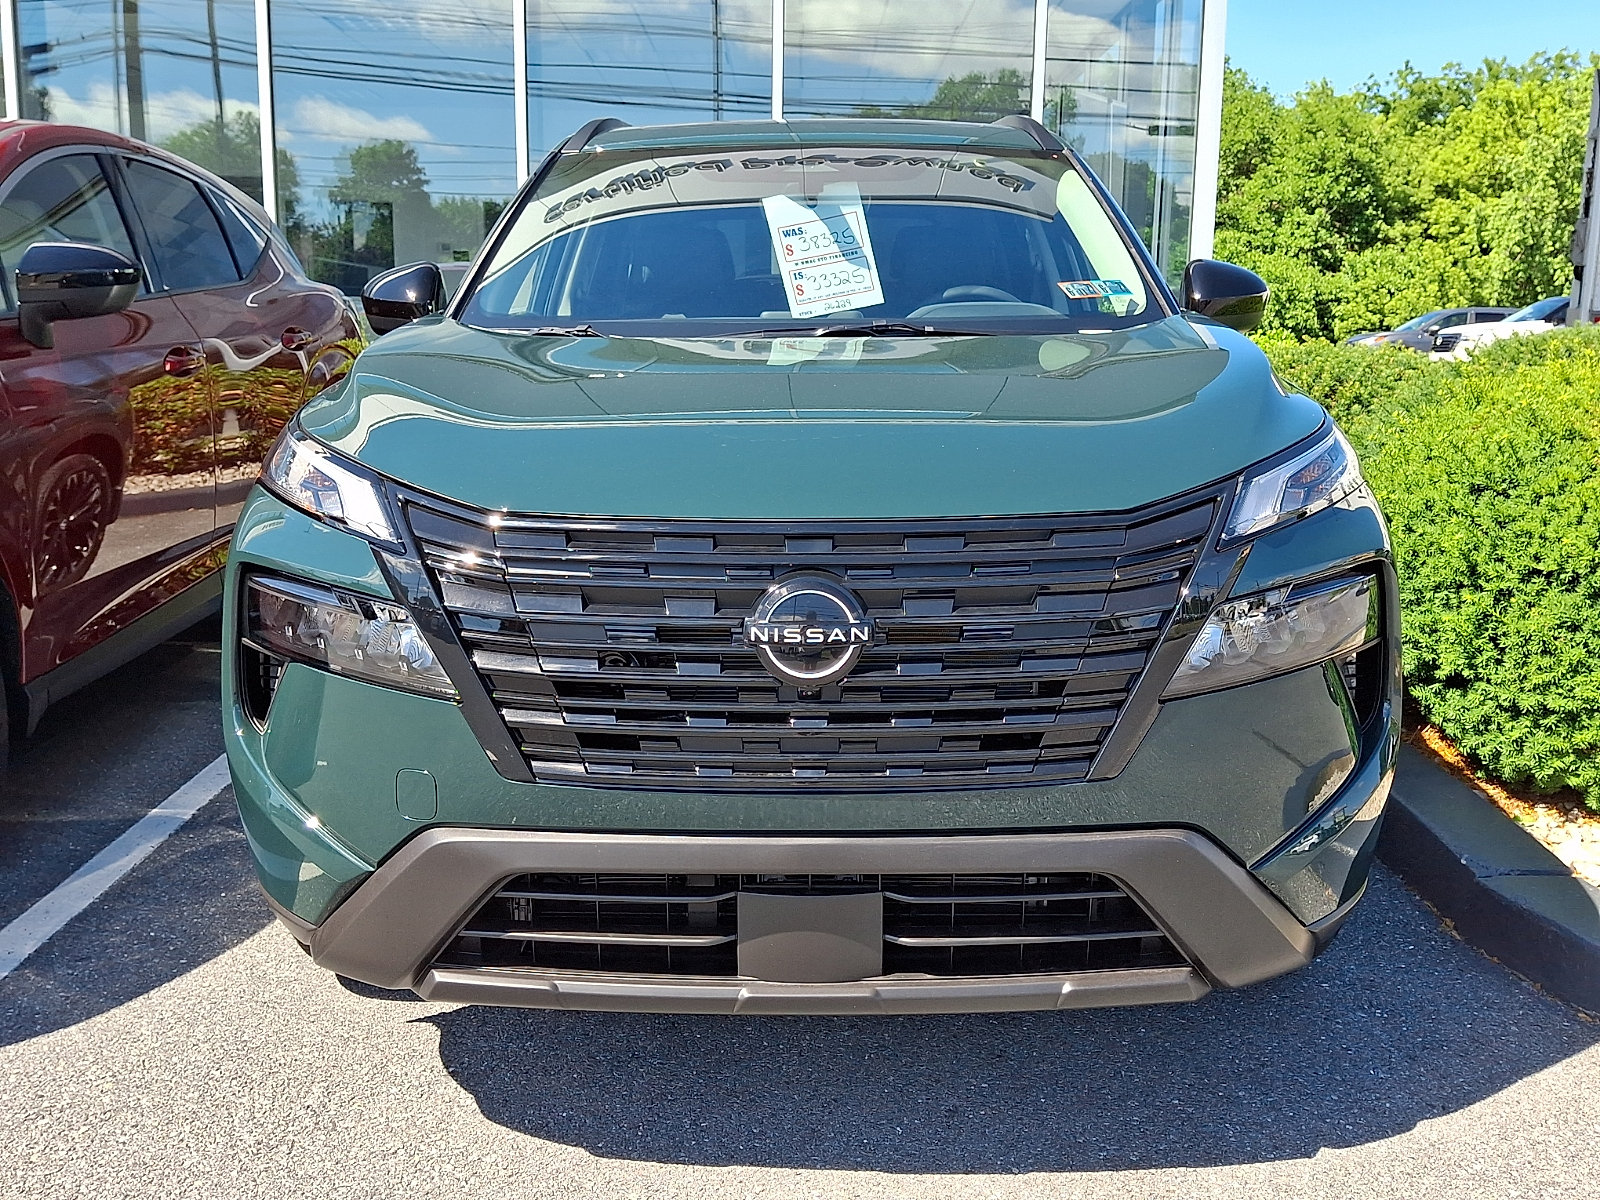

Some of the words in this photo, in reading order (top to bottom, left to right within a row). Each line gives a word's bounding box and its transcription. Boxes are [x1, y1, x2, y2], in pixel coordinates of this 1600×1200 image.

[782, 227, 807, 238] WAS:
[798, 227, 855, 252] 38325
[793, 271, 807, 281] IS:
[806, 267, 866, 291] 33325
[750, 626, 869, 643] NISSAN
